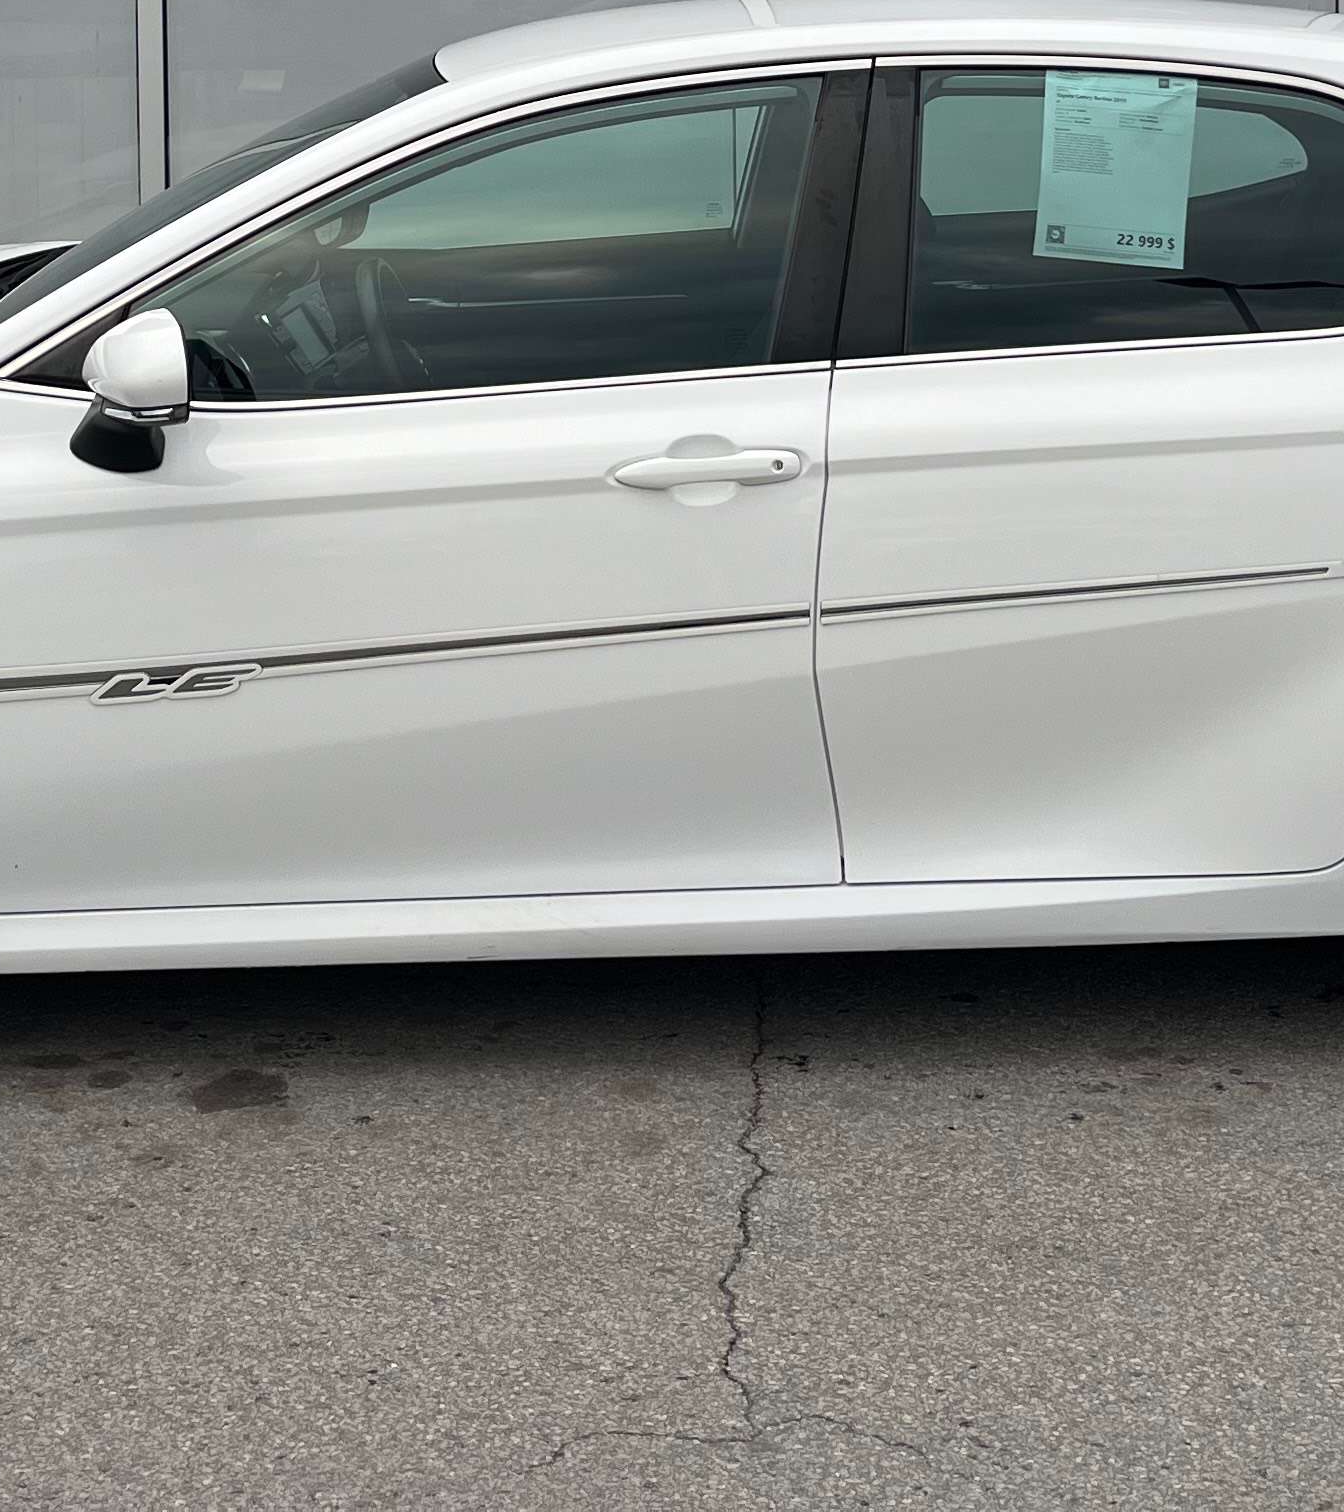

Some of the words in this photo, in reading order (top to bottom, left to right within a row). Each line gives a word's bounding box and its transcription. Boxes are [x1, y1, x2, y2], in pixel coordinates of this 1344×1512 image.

[1116, 233, 1134, 246] 22
[1138, 235, 1163, 249] 999
[1167, 237, 1176, 250] $
